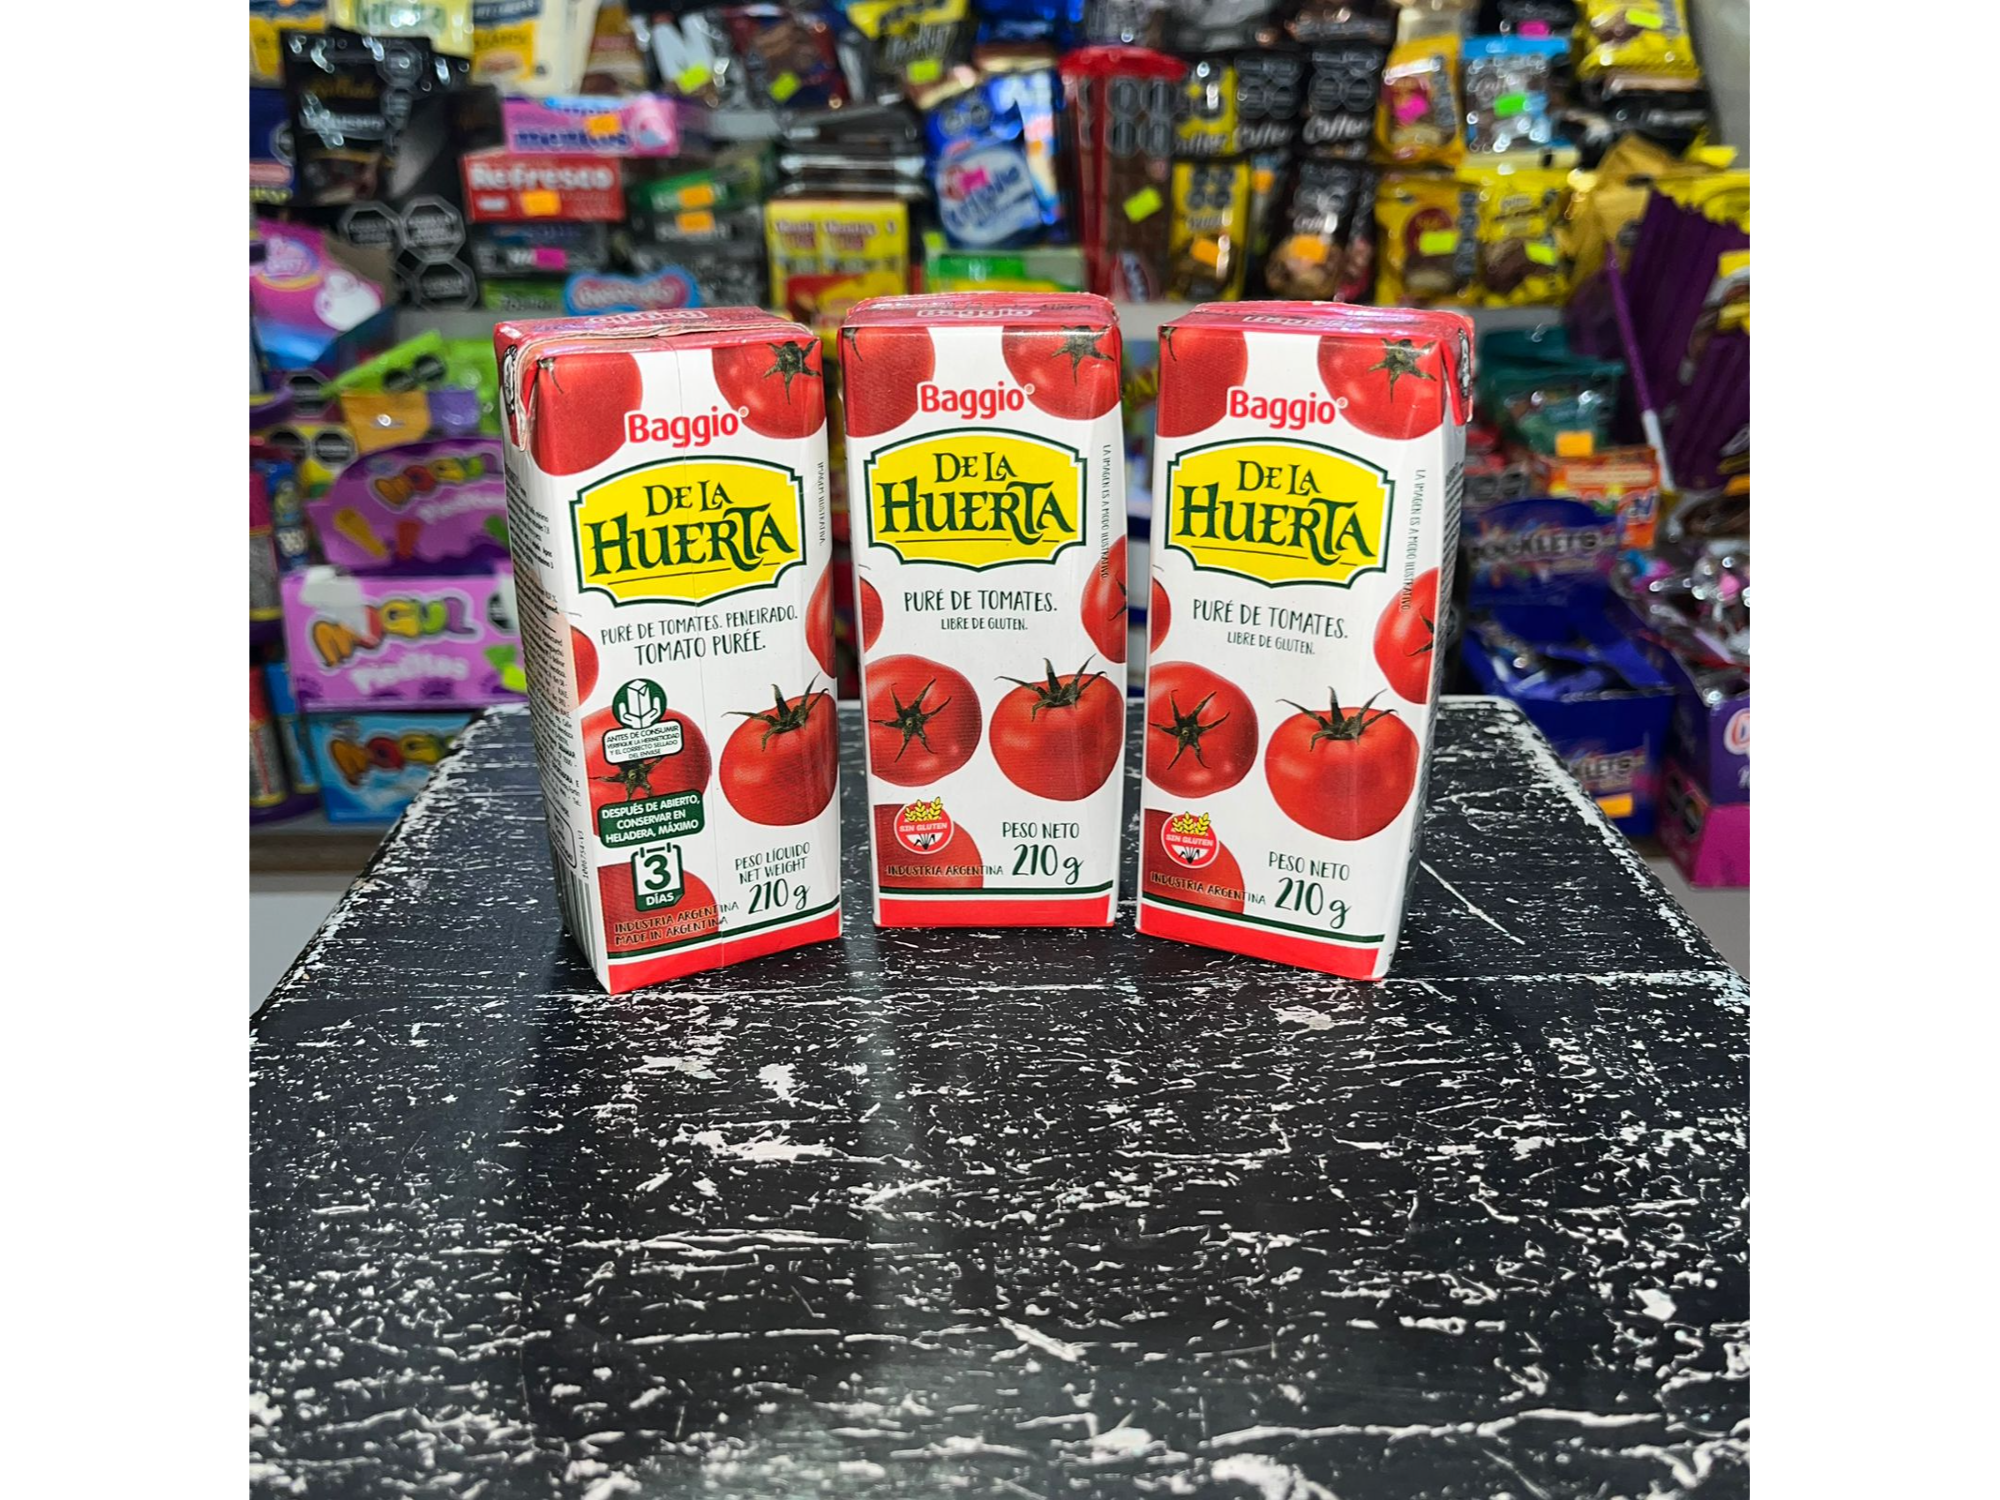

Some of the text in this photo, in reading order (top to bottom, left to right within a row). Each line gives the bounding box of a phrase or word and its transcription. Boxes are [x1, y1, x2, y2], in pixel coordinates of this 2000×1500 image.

[921, 381, 1024, 419] Baggio
[1229, 390, 1336, 430] Baggio
[628, 405, 738, 448] Baggio
[983, 452, 1017, 481] LA
[1102, 458, 1110, 487] IMAGEN
[1286, 464, 1321, 495] LA
[1415, 469, 1426, 480] LA
[698, 480, 733, 512] LA
[876, 476, 1077, 545] HUERTA
[1411, 482, 1425, 515] IMAGEN
[1101, 508, 1109, 530] MODO
[1176, 483, 1376, 565] HUERTA
[1410, 516, 1421, 526] ES
[583, 502, 796, 577] HUERTA
[1406, 536, 1418, 560] MODO
[904, 589, 1058, 612] PURÉ DE TOMATES.
[601, 605, 798, 645] PURÉ DE TOMATES. PENEIRADO.
[941, 618, 1028, 630] LIBRE DE GLUTEN.
[1193, 599, 1348, 639] PURÉ DE TOMATES.
[634, 630, 766, 666] TOMATO PURÉE.
[1227, 631, 1316, 655] LIBRE DE GLUTEN.
[607, 725, 679, 743] ANTES DE CONSUMIR
[607, 740, 633, 749] VERIFIQUE
[641, 733, 680, 744] HERMETICIDAD
[622, 744, 652, 754] CORRECTO
[654, 740, 678, 748] SELLADO
[602, 794, 700, 819] DESPUÉS DE ABIERTO,
[616, 810, 686, 829] CONSERVAR EN
[605, 819, 699, 844] HELADERA, MÁXIMO
[916, 822, 947, 832] GLUTEN
[1003, 822, 1080, 839] PESO NETO
[1166, 833, 1214, 847] SIN GLUTEN
[735, 842, 810, 871] PESO LÍQUIDO
[739, 857, 807, 884] NET WEIGHT
[887, 865, 1004, 876] INDUSTRIA ARGENTINA
[1012, 843, 1083, 885] 210 g
[1269, 851, 1350, 881] PESO NETO
[644, 854, 671, 890] 3
[646, 891, 674, 906] DÍAS
[749, 878, 810, 914] 210 g
[1151, 871, 1266, 905] INDUSTRIA ARGENTINA
[1274, 876, 1352, 929] 210 g
[615, 901, 739, 932] INDUSTRIA ARGENTINA
[615, 916, 729, 945] MADE IN ARGENTINA
